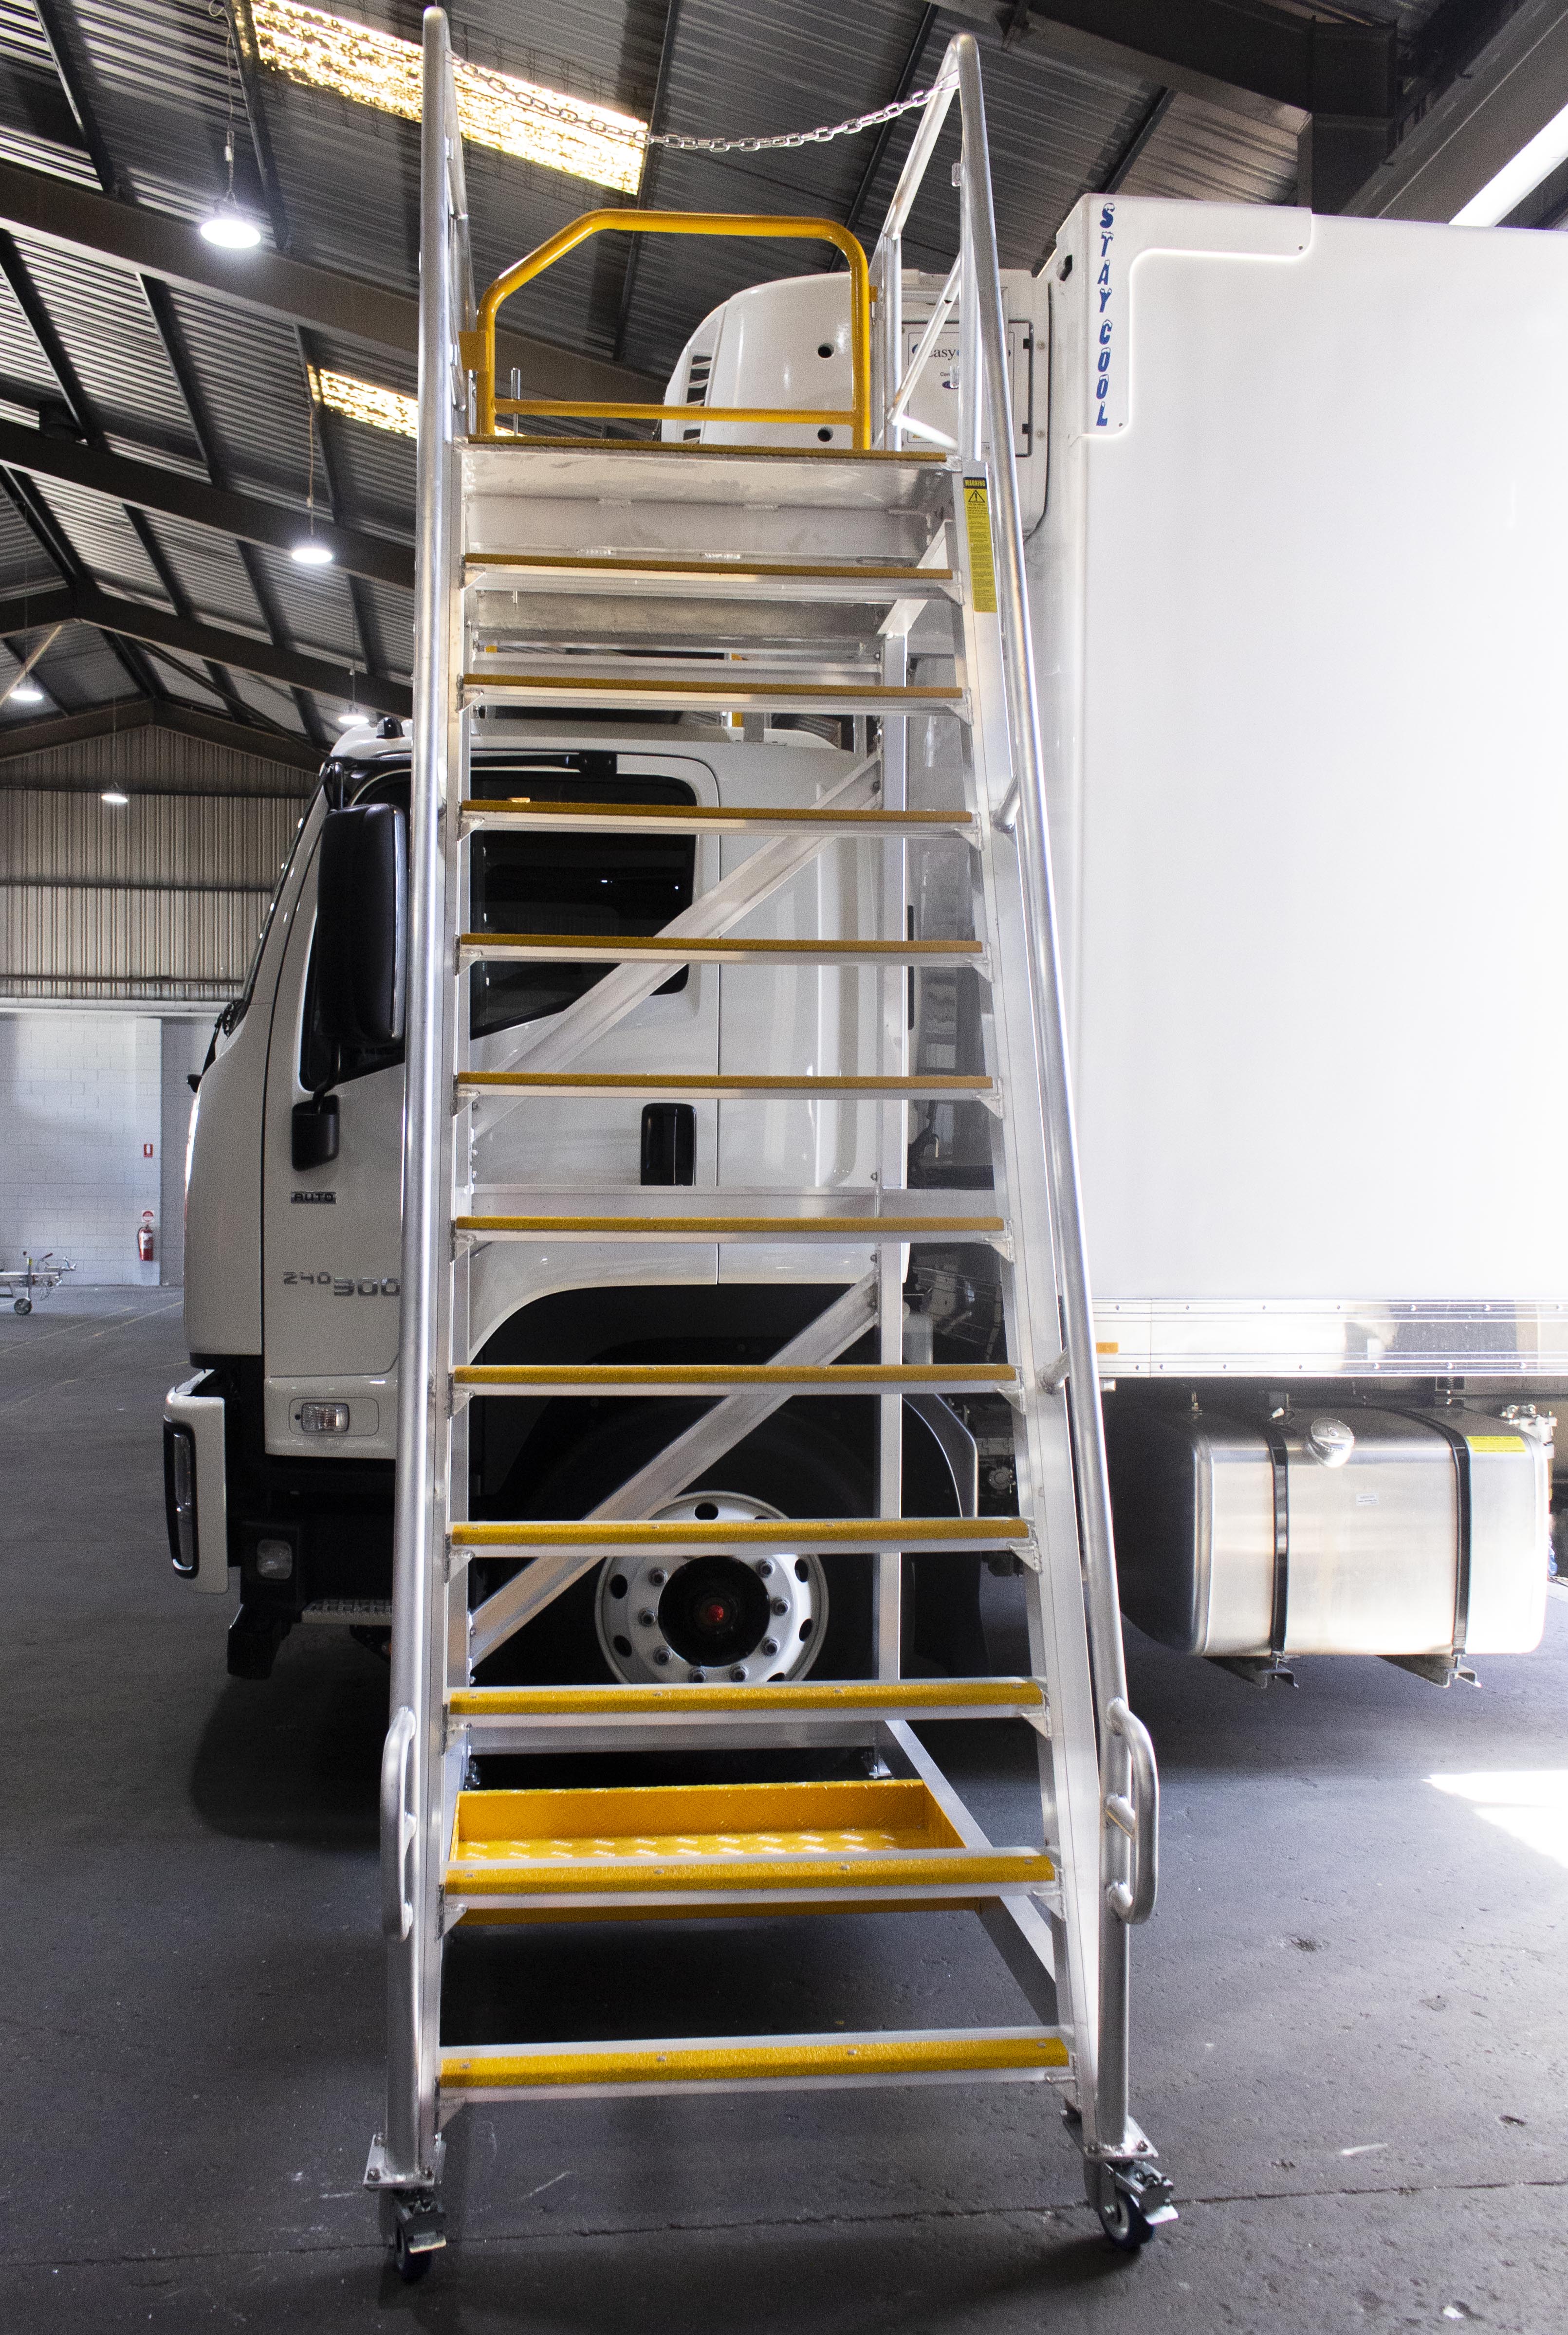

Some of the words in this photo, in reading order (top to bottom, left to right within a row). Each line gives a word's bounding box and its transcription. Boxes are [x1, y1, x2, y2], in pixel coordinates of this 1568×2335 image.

[1097, 202, 1115, 313] STAY
[1096, 319, 1113, 426] COOL
[294, 1193, 334, 1202] AUTO
[284, 1271, 331, 1285] 240
[334, 1277, 400, 1296] 300
